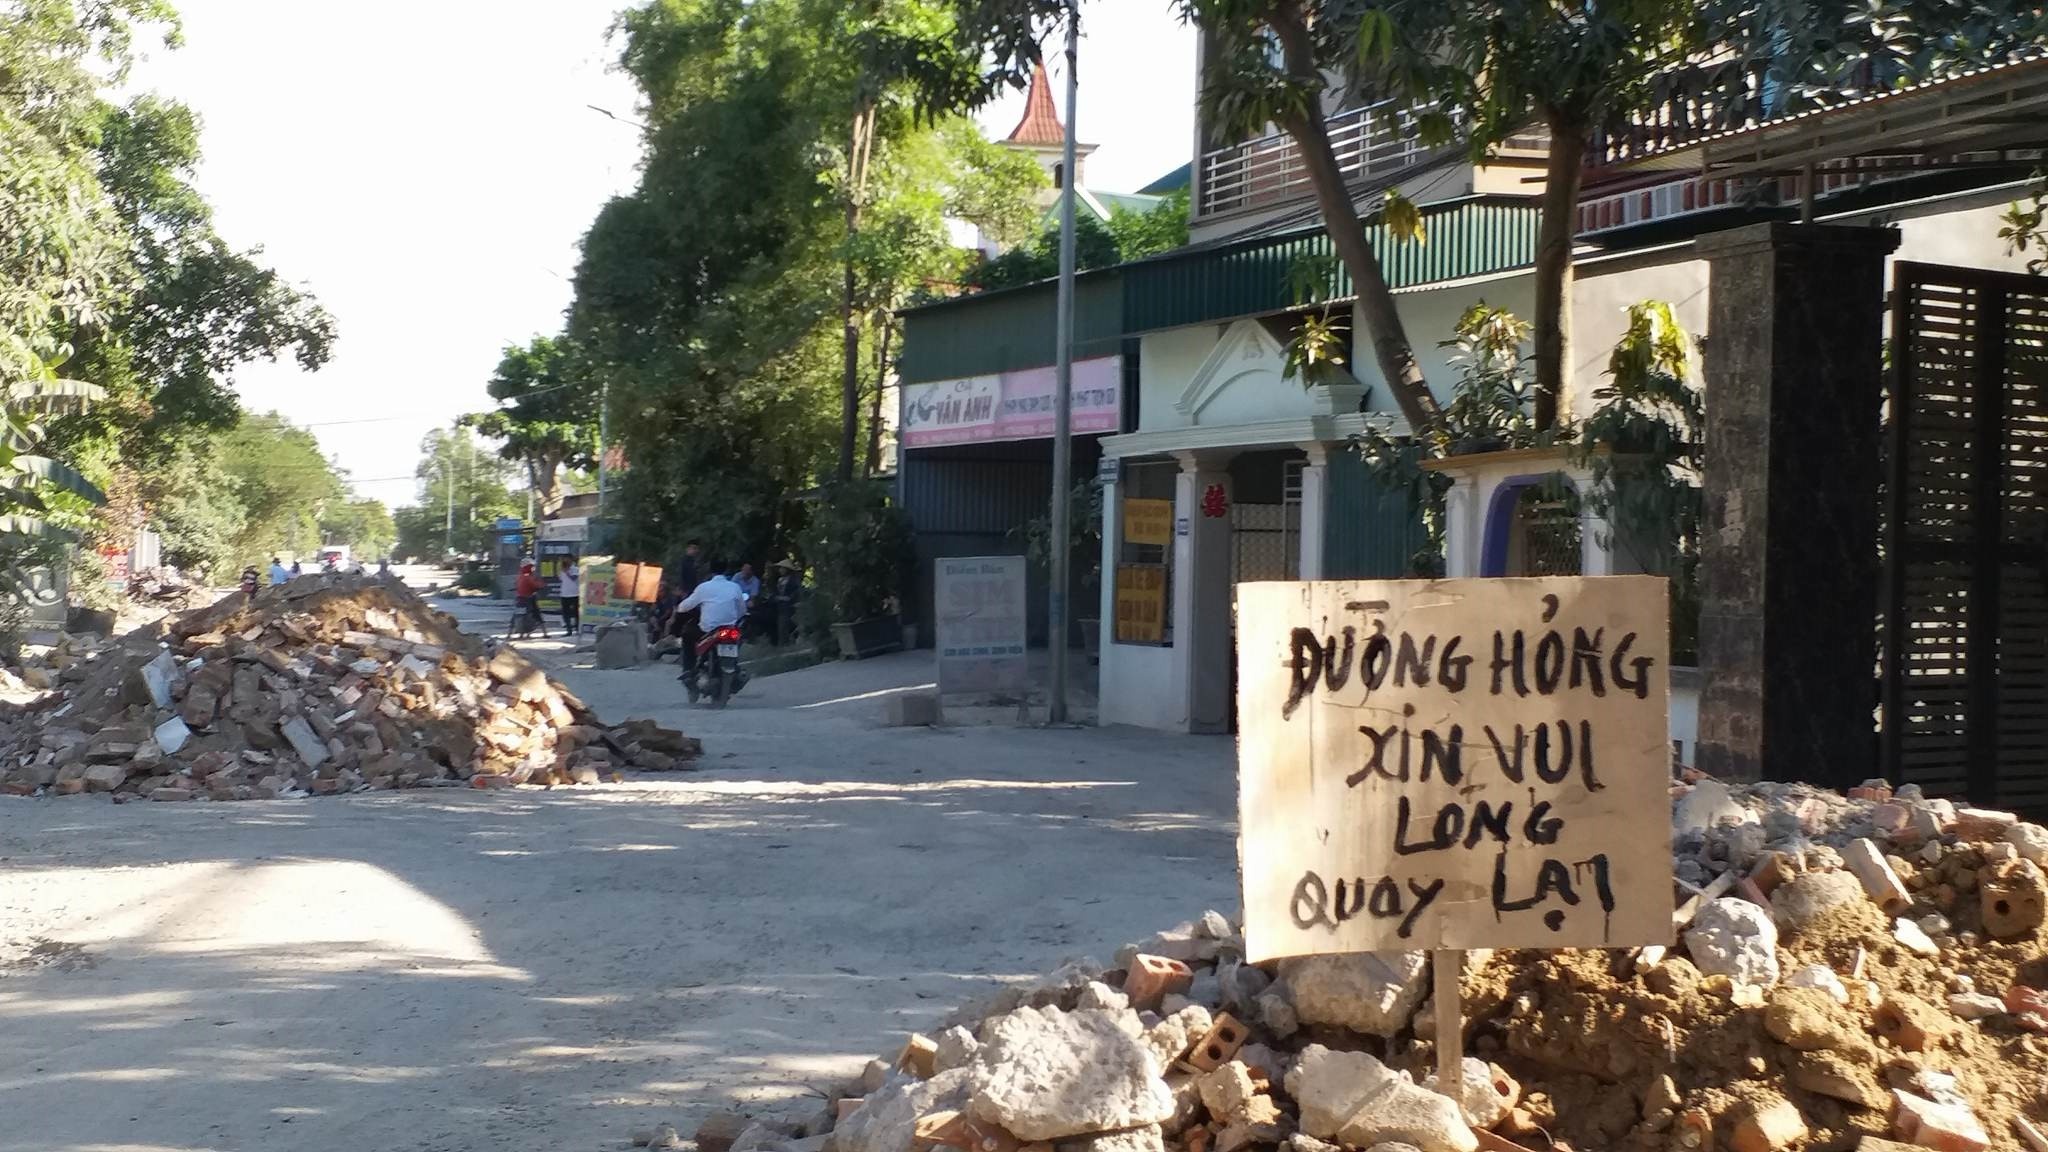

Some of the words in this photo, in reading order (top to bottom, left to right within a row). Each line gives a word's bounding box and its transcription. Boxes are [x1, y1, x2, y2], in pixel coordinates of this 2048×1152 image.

[1346, 703, 1463, 787] XIN
[1484, 720, 1606, 791] VUI
[1493, 853, 1614, 931] LẠI
